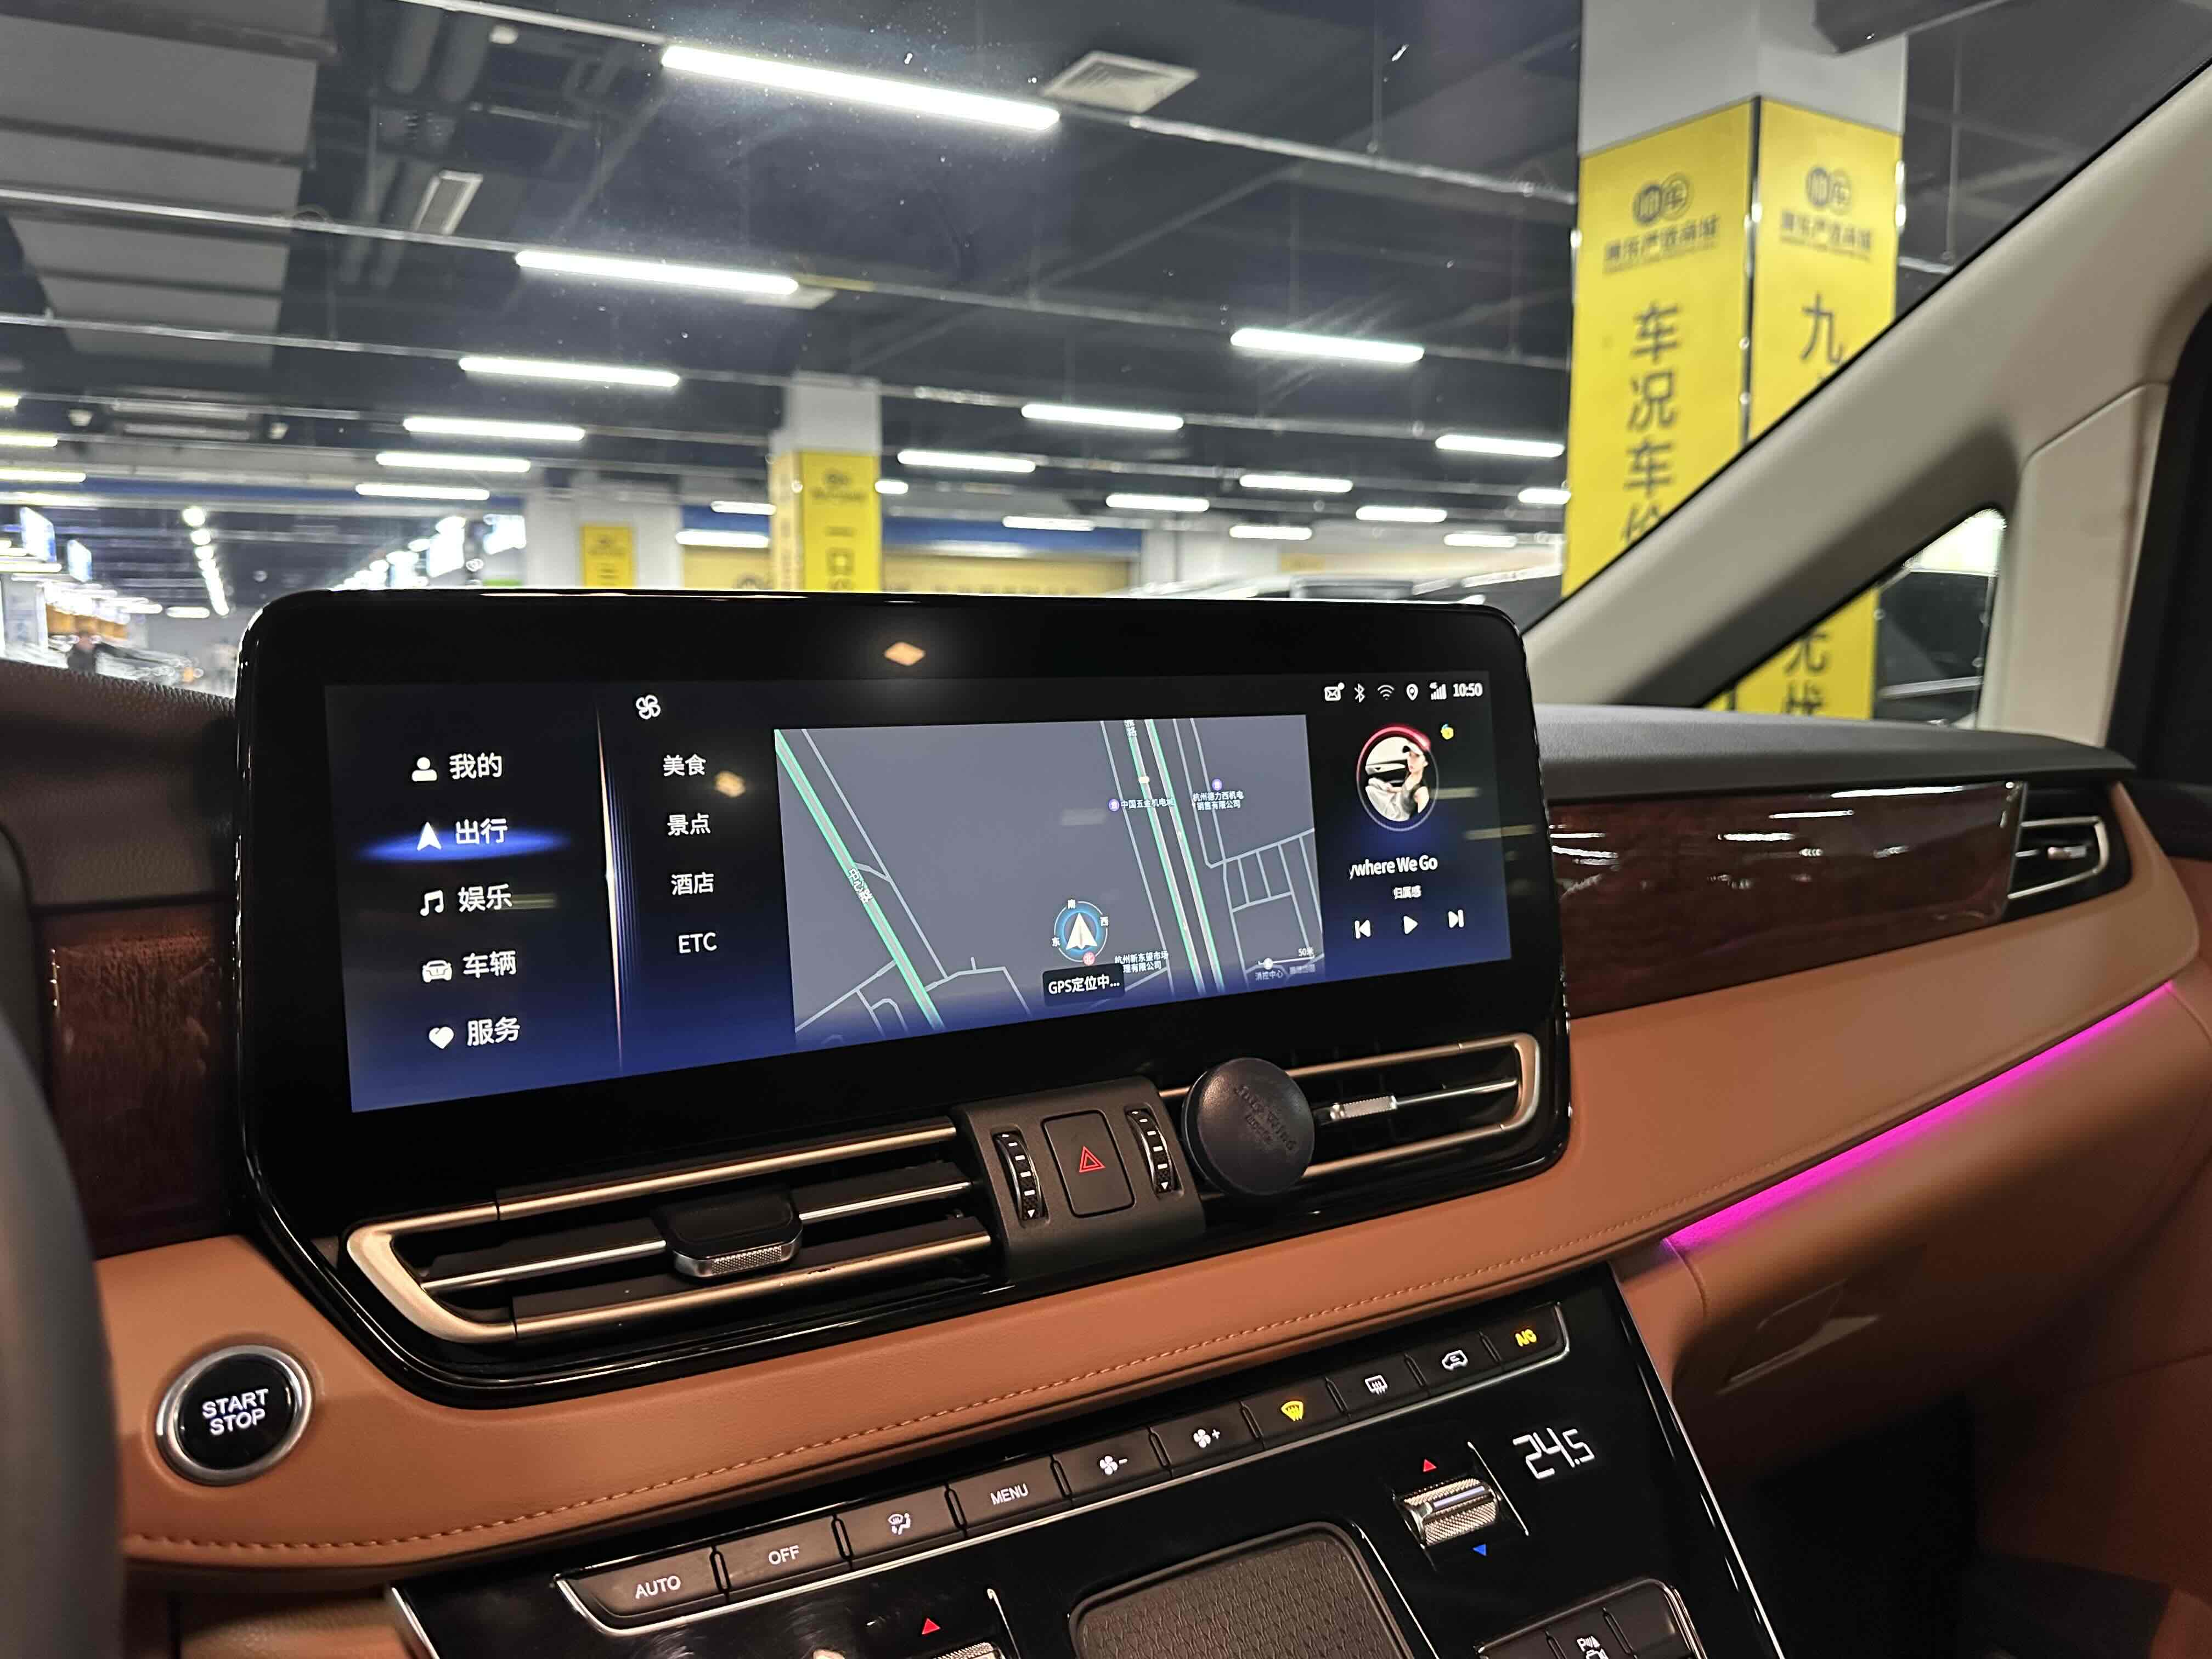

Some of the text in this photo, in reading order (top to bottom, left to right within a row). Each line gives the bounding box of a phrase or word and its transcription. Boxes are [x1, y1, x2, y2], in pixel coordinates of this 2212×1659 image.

[1453, 682, 1483, 697] 10:50
[449, 752, 503, 780] 我的
[663, 754, 707, 777] 美食
[455, 818, 508, 845] 出行
[667, 812, 711, 836] 景点
[1396, 857, 1418, 872] We
[1419, 855, 1438, 871] Go
[671, 871, 714, 895] 酒店
[848, 868, 873, 904] 中心路
[458, 883, 512, 912] 娱乐
[678, 932, 717, 953] ETC
[462, 950, 516, 979] 车辆
[467, 1017, 521, 1046] 服务
[202, 1389, 269, 1419] START
[210, 1408, 266, 1436] STOP
[1513, 1427, 1595, 1480] 24.5
[990, 1483, 1029, 1505] MENU
[768, 1544, 799, 1565] OFF
[635, 1575, 681, 1599] AUTO
